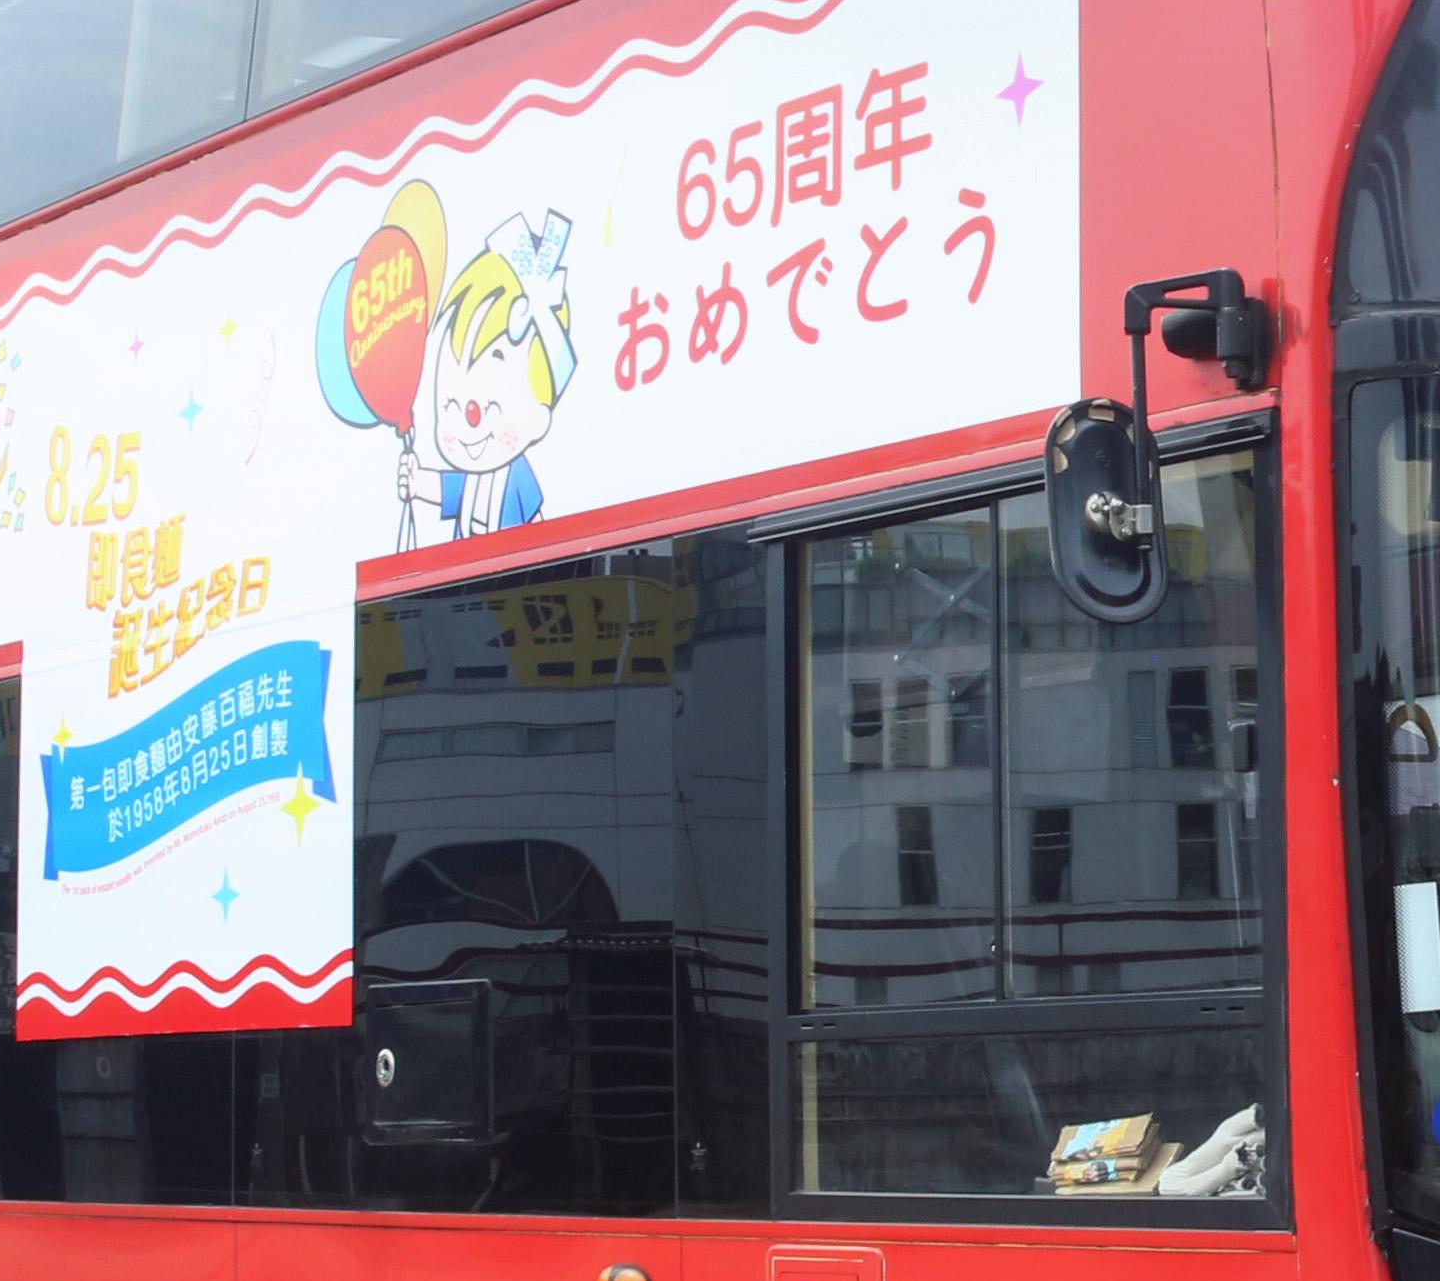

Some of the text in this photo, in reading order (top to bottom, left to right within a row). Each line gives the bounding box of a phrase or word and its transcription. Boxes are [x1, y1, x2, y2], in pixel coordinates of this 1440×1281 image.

[676, 60, 934, 242] 65周年
[350, 295, 427, 369] Anniversary
[351, 248, 414, 334] 65th
[614, 188, 996, 392] おめでとう
[44, 423, 143, 527] 8.25
